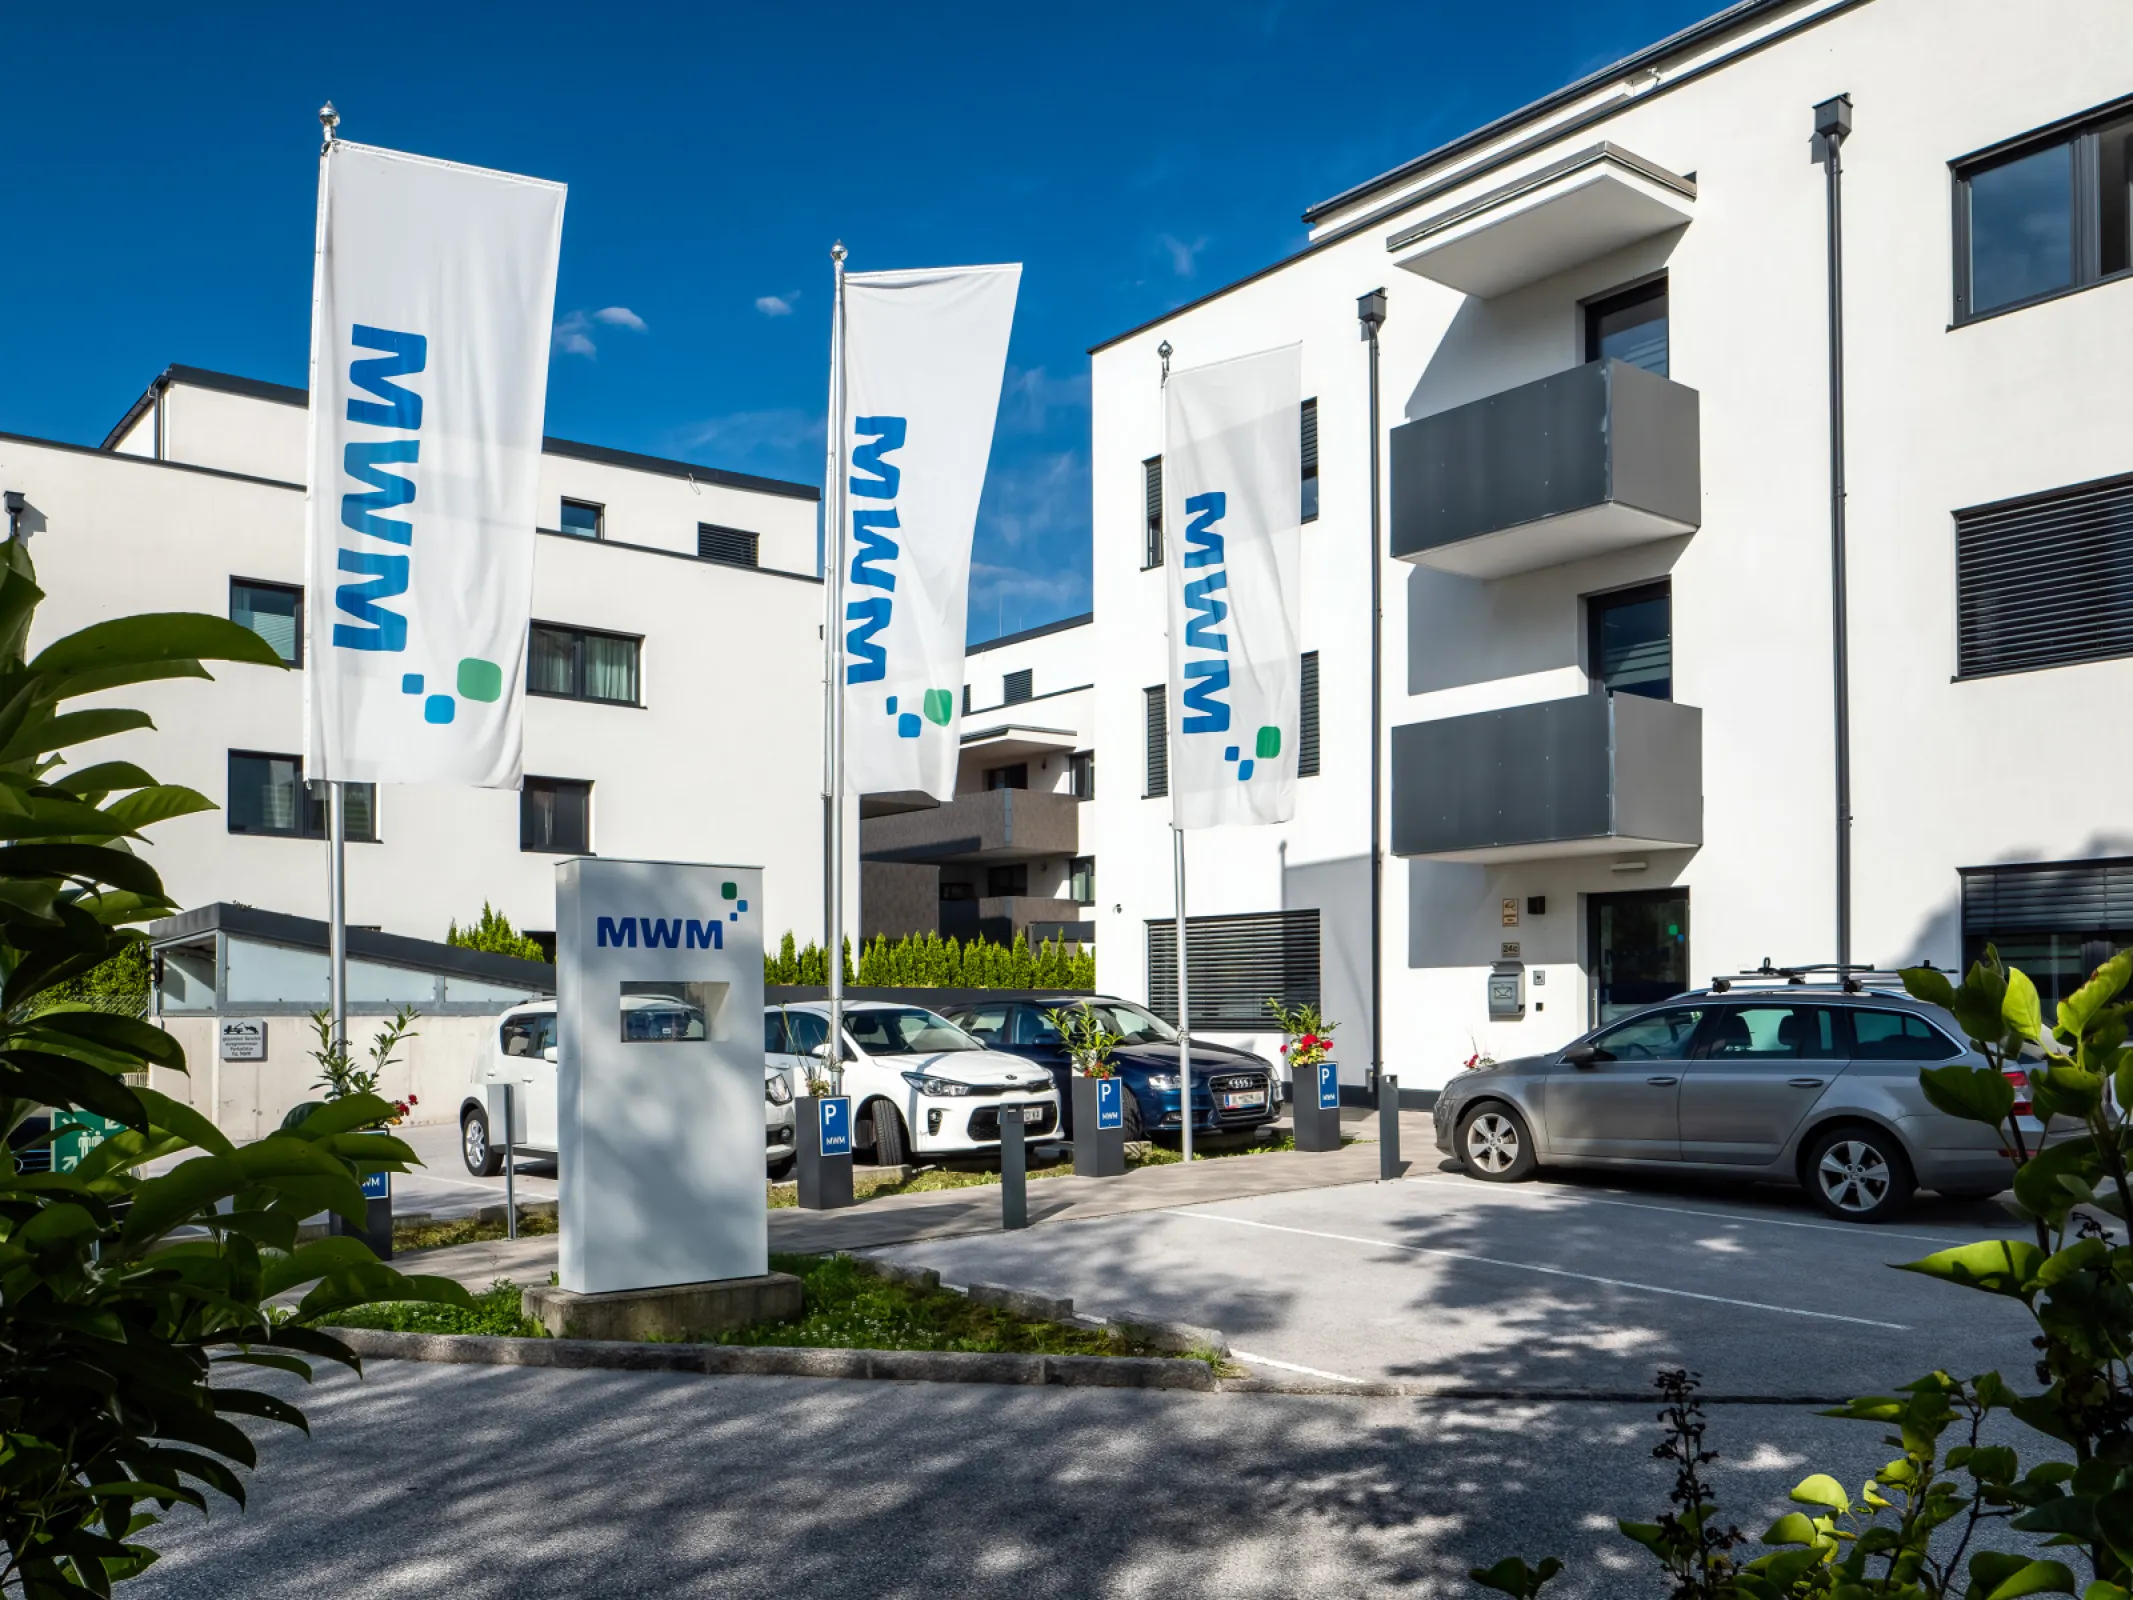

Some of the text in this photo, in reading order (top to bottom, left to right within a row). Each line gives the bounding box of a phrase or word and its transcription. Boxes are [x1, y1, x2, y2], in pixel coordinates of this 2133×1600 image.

[332, 323, 427, 652] MWM
[846, 415, 907, 685] MWM
[1182, 491, 1231, 734] MWM
[597, 916, 723, 950] MWM
[1321, 1067, 1330, 1085] P
[1101, 1083, 1112, 1102] P
[824, 1103, 837, 1125] P
[826, 1135, 846, 1145] MWM
